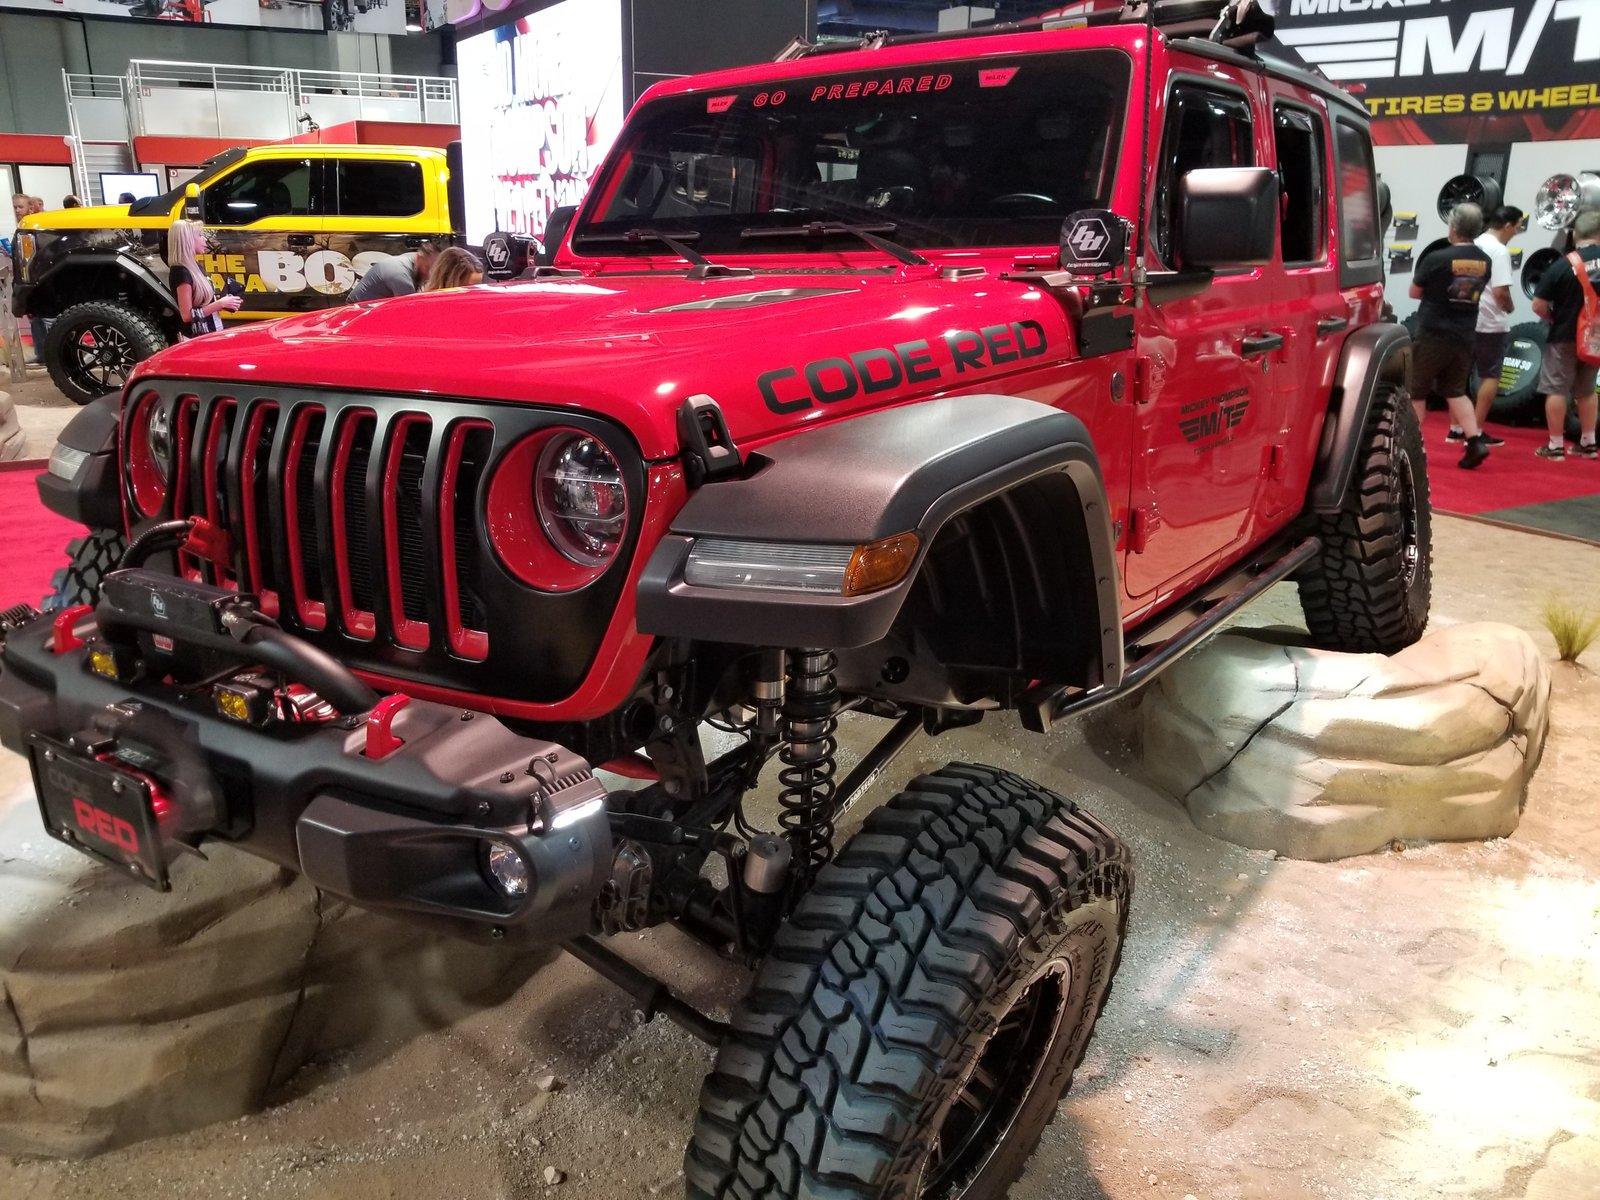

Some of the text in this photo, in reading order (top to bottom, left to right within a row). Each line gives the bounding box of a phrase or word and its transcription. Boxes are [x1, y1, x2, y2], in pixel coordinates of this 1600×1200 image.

[753, 74, 952, 107] GO PREPARED
[1364, 93, 1465, 117] TIRES
[1470, 92, 1495, 112] &
[195, 254, 246, 273] HE
[757, 320, 1048, 415] CODE RED
[72, 798, 139, 853] RED
